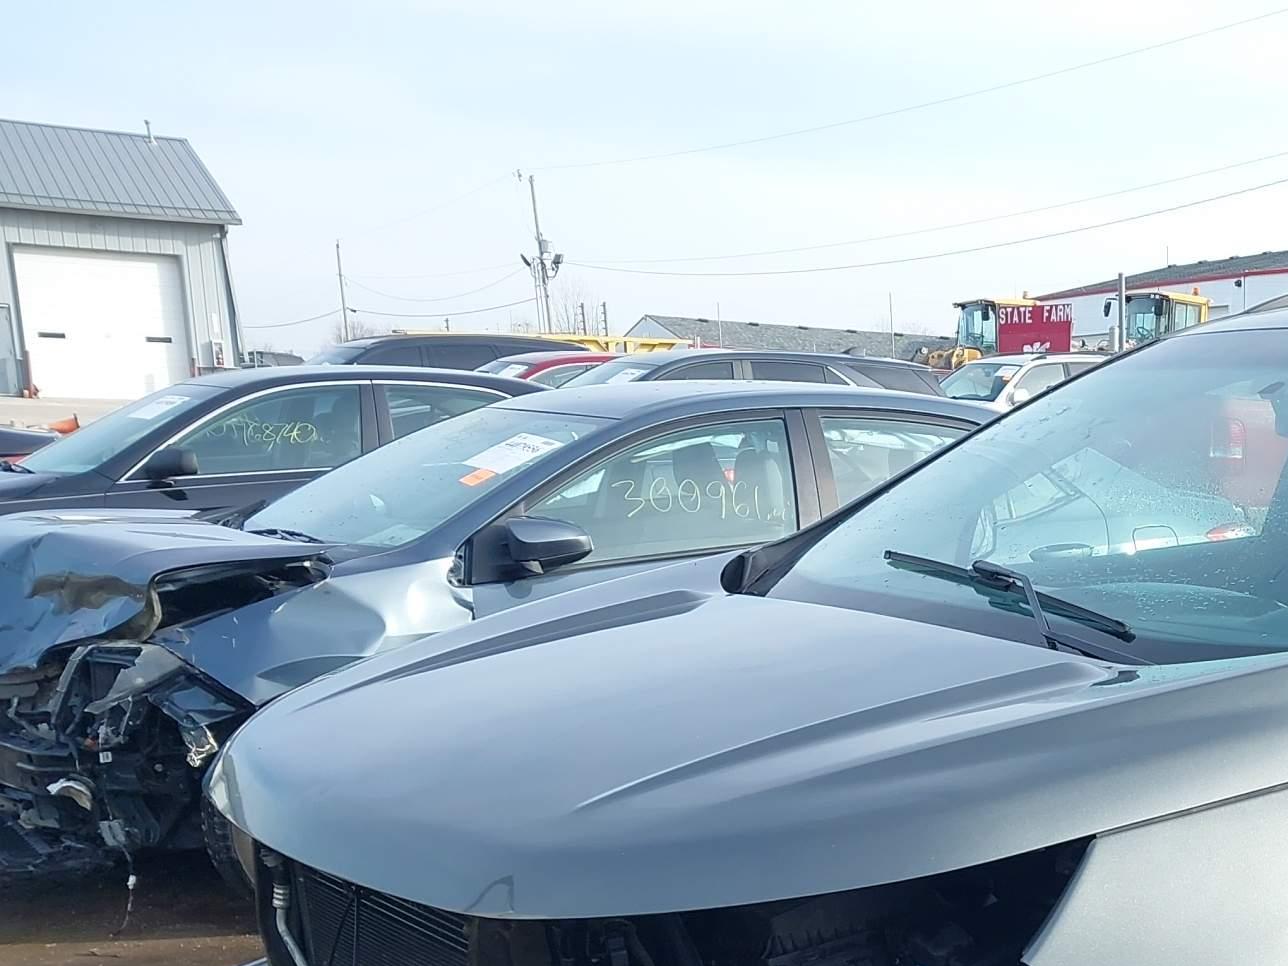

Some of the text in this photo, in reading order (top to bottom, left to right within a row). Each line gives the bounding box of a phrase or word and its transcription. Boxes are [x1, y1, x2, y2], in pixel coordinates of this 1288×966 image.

[999, 304, 1072, 325] STATE FARM
[611, 475, 761, 520] 300961
